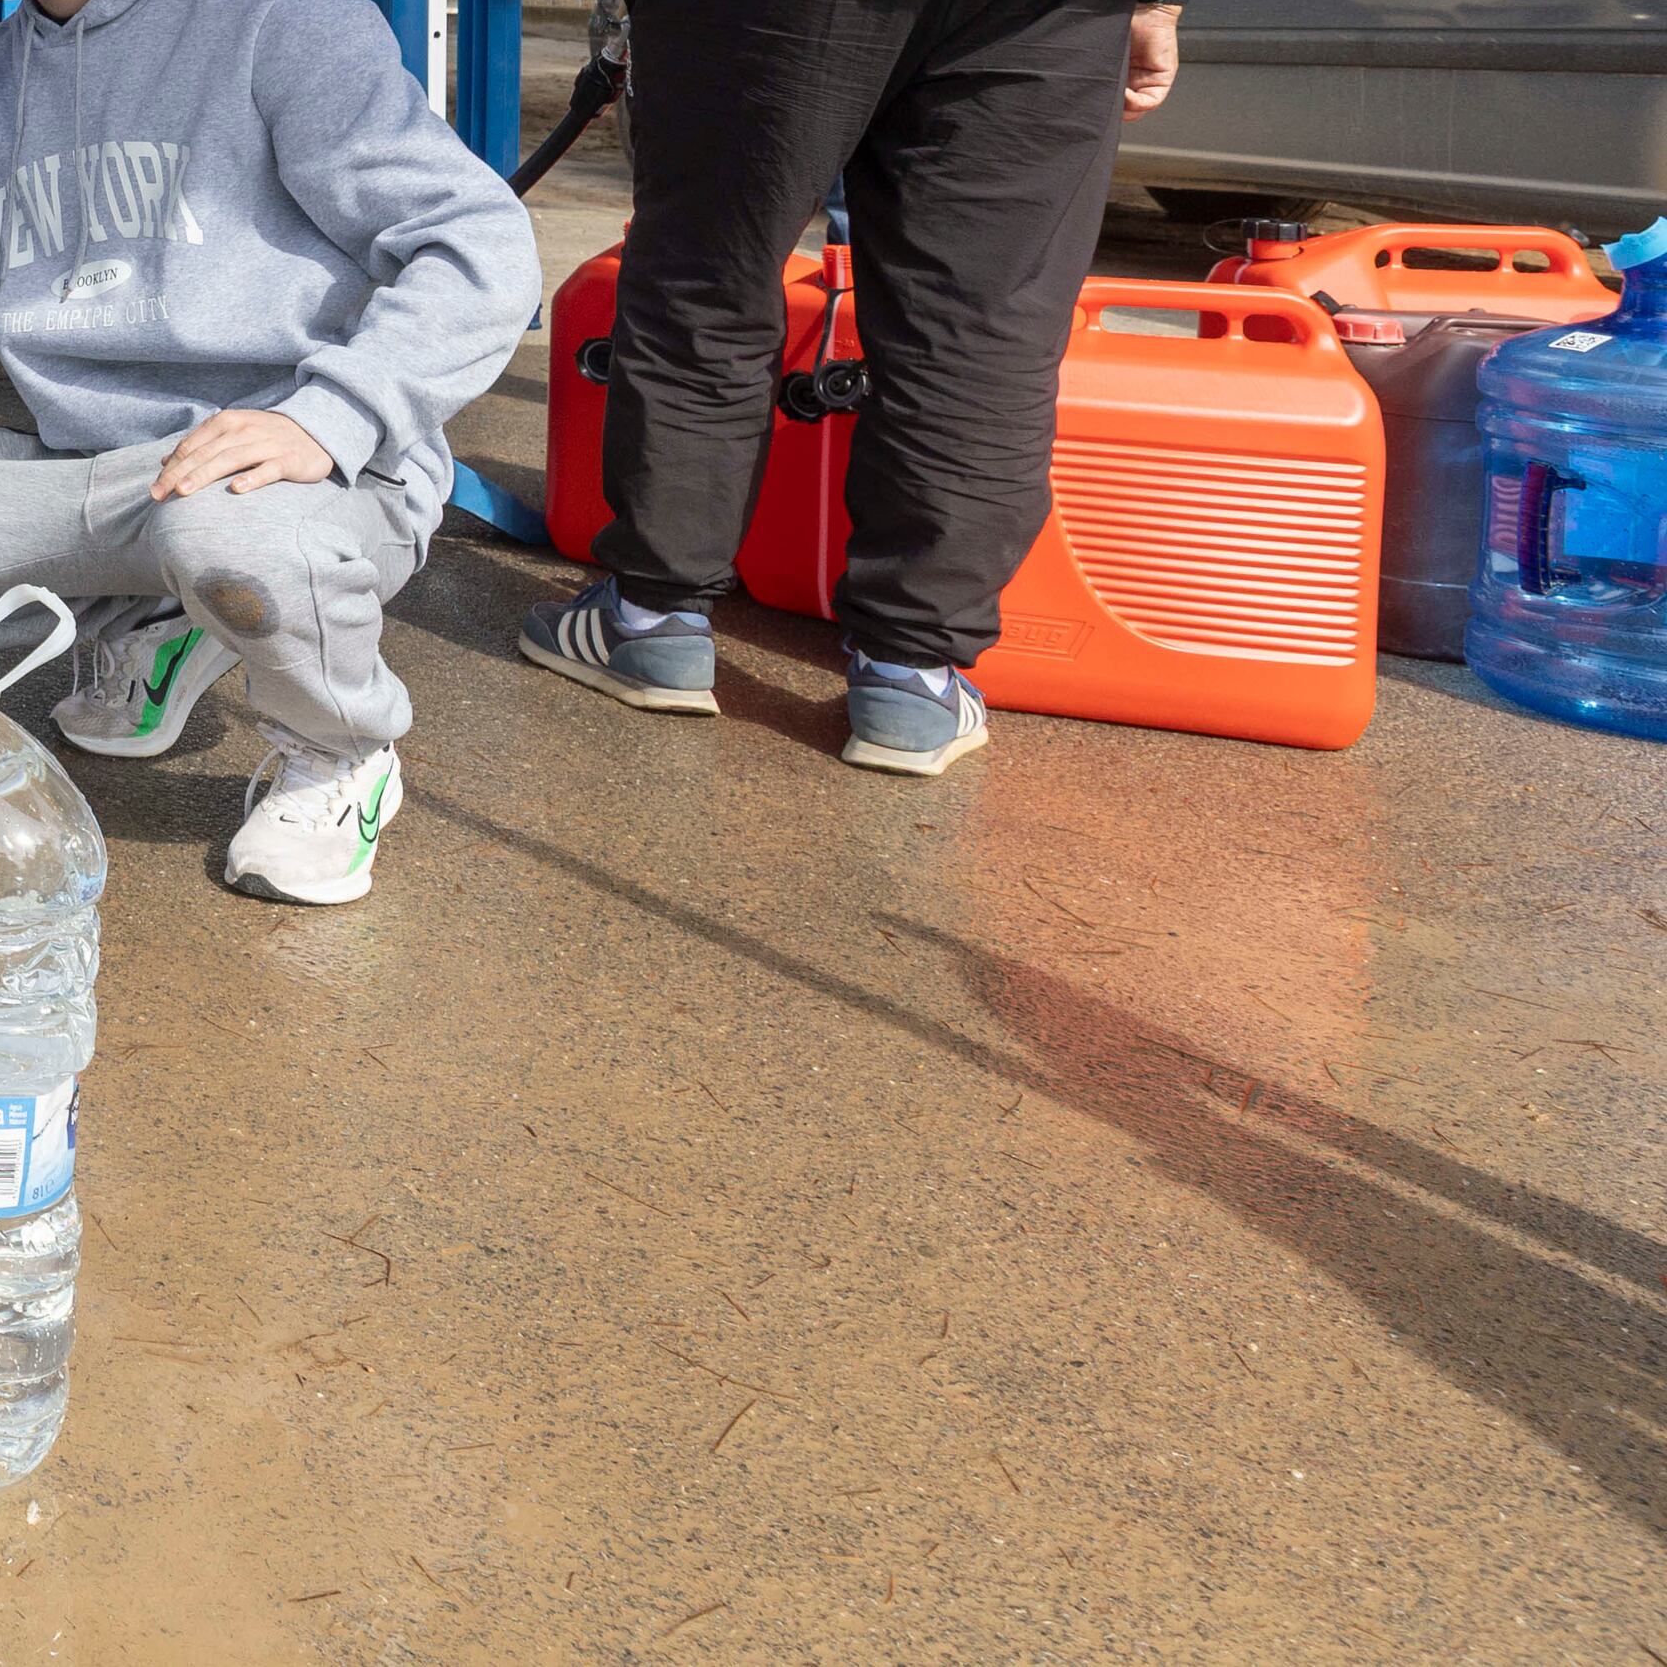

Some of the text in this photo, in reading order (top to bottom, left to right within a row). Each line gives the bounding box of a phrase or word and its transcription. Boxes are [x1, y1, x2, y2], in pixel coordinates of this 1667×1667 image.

[72, 141, 204, 246] YORK
[62, 267, 118, 291] BOOKLYN
[2, 310, 35, 334] THE
[126, 294, 170, 325] CITY
